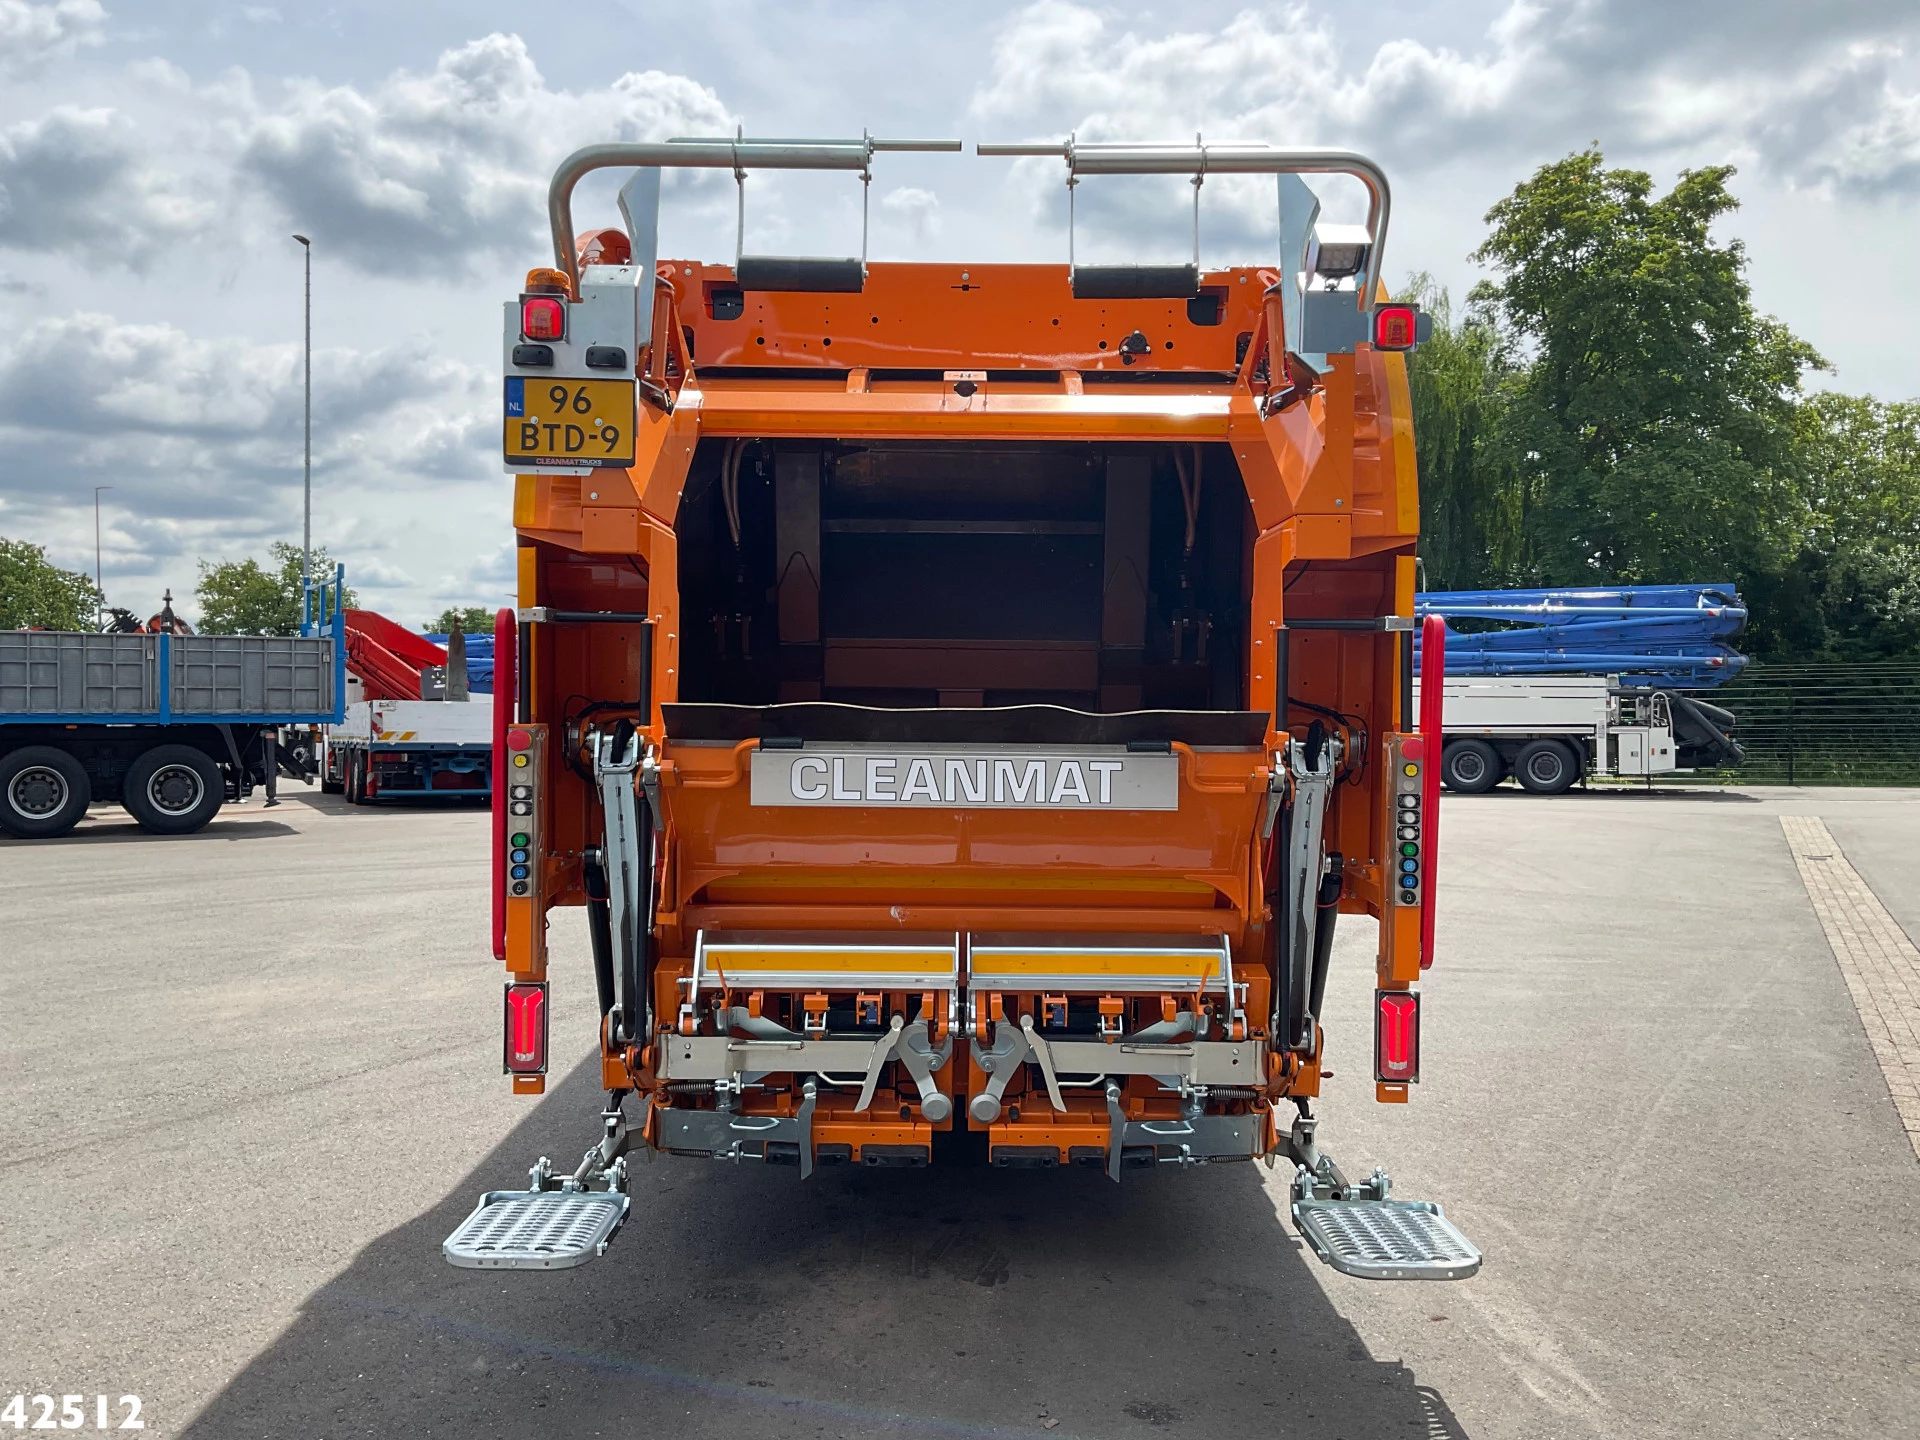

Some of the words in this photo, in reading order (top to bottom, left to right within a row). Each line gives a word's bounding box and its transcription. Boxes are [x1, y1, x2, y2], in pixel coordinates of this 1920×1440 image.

[508, 402, 522, 412] NL
[549, 385, 592, 414] 96
[520, 423, 620, 453] BTD-9
[790, 757, 1124, 804] CLEANMAT
